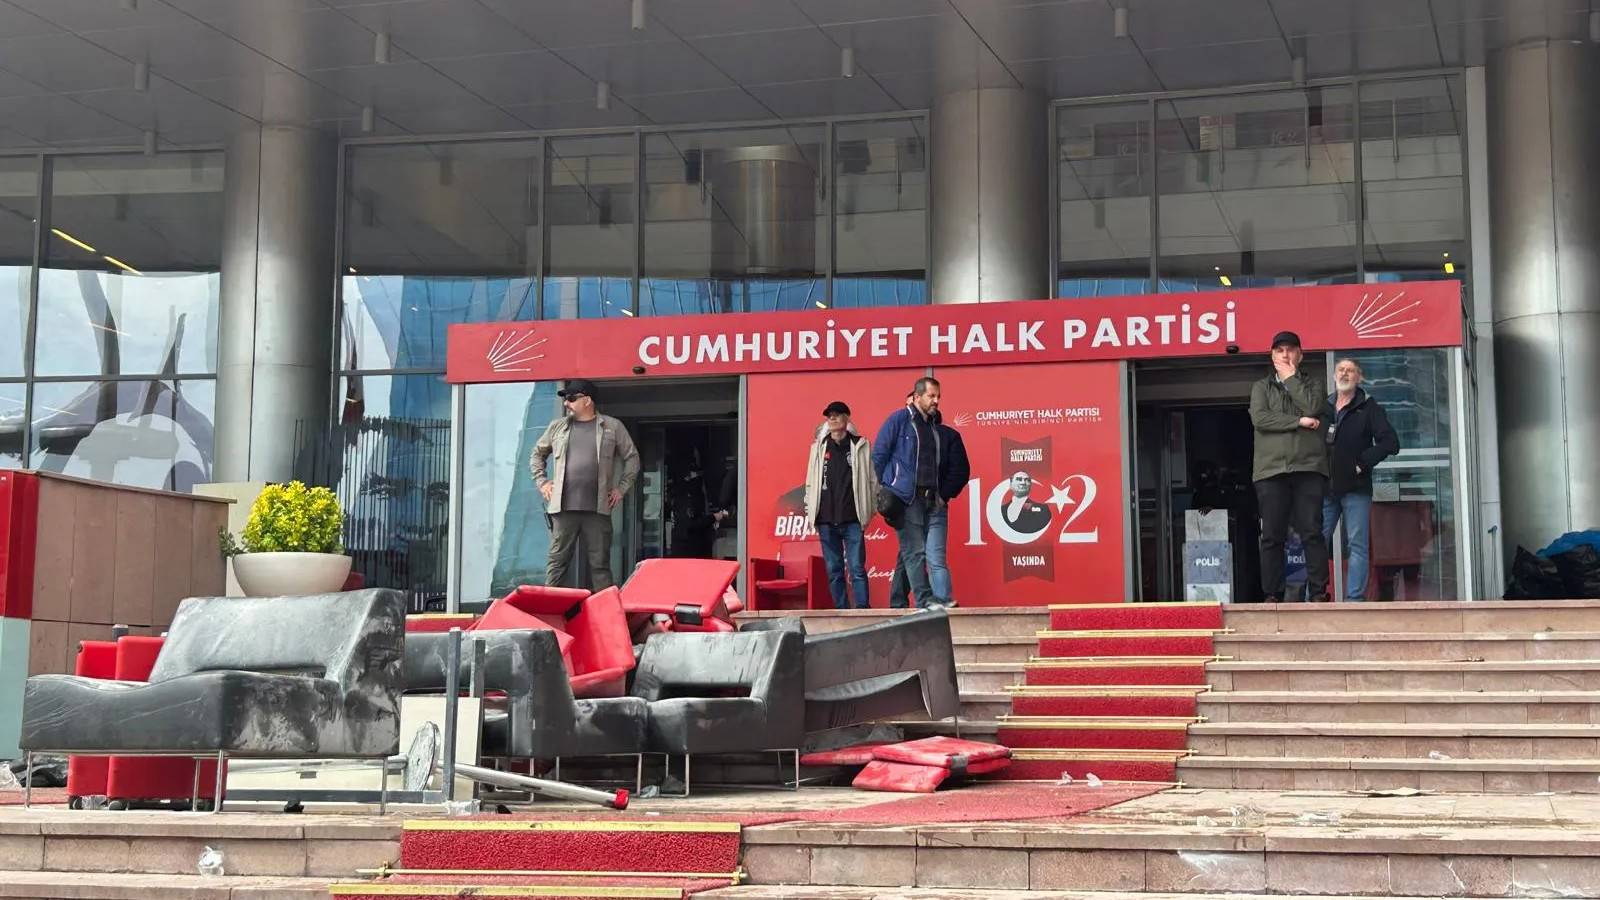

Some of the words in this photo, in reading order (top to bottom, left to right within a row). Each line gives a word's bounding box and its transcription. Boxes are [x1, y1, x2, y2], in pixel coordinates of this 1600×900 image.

[638, 319, 912, 366] CUMHURİYET
[930, 320, 1046, 355] HALK
[1064, 301, 1236, 348] PARTİSİ
[1038, 409, 1062, 418] HALK
[1012, 556, 1045, 567] YAŞINDA
[1195, 556, 1220, 566] POLİS
